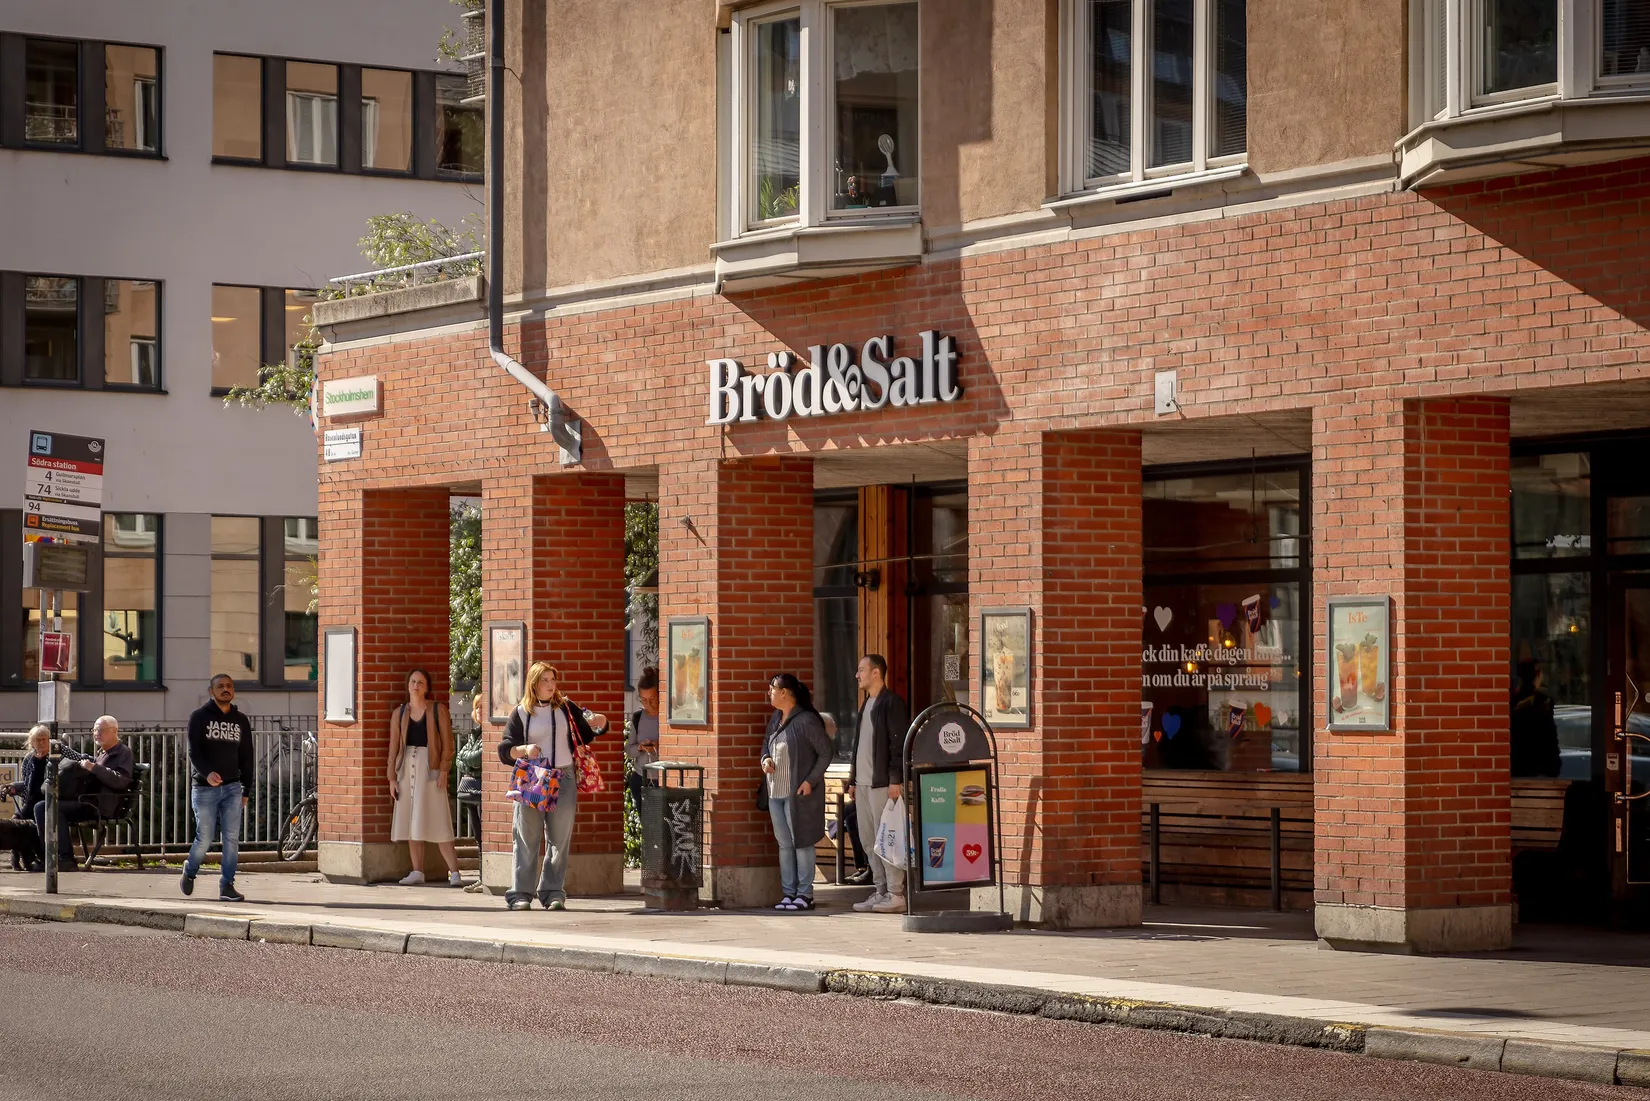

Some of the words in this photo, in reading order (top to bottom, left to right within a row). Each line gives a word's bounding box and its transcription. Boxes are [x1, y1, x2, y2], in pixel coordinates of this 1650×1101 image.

[705, 330, 963, 425] Bröd&Salt
[325, 388, 374, 404] Stockholmshem
[31, 457, 52, 467] Södra
[52, 460, 77, 470] station
[45, 470, 52, 481] 4
[37, 483, 51, 495] 74
[28, 501, 40, 511] 94
[1158, 644, 1179, 662] din
[1180, 643, 1213, 661] kaffe
[1214, 645, 1252, 665] dagen
[1152, 674, 1173, 687] om
[1173, 668, 1190, 687] du
[1191, 669, 1206, 687] är
[1207, 667, 1224, 690] på
[205, 729, 241, 741] JONES
